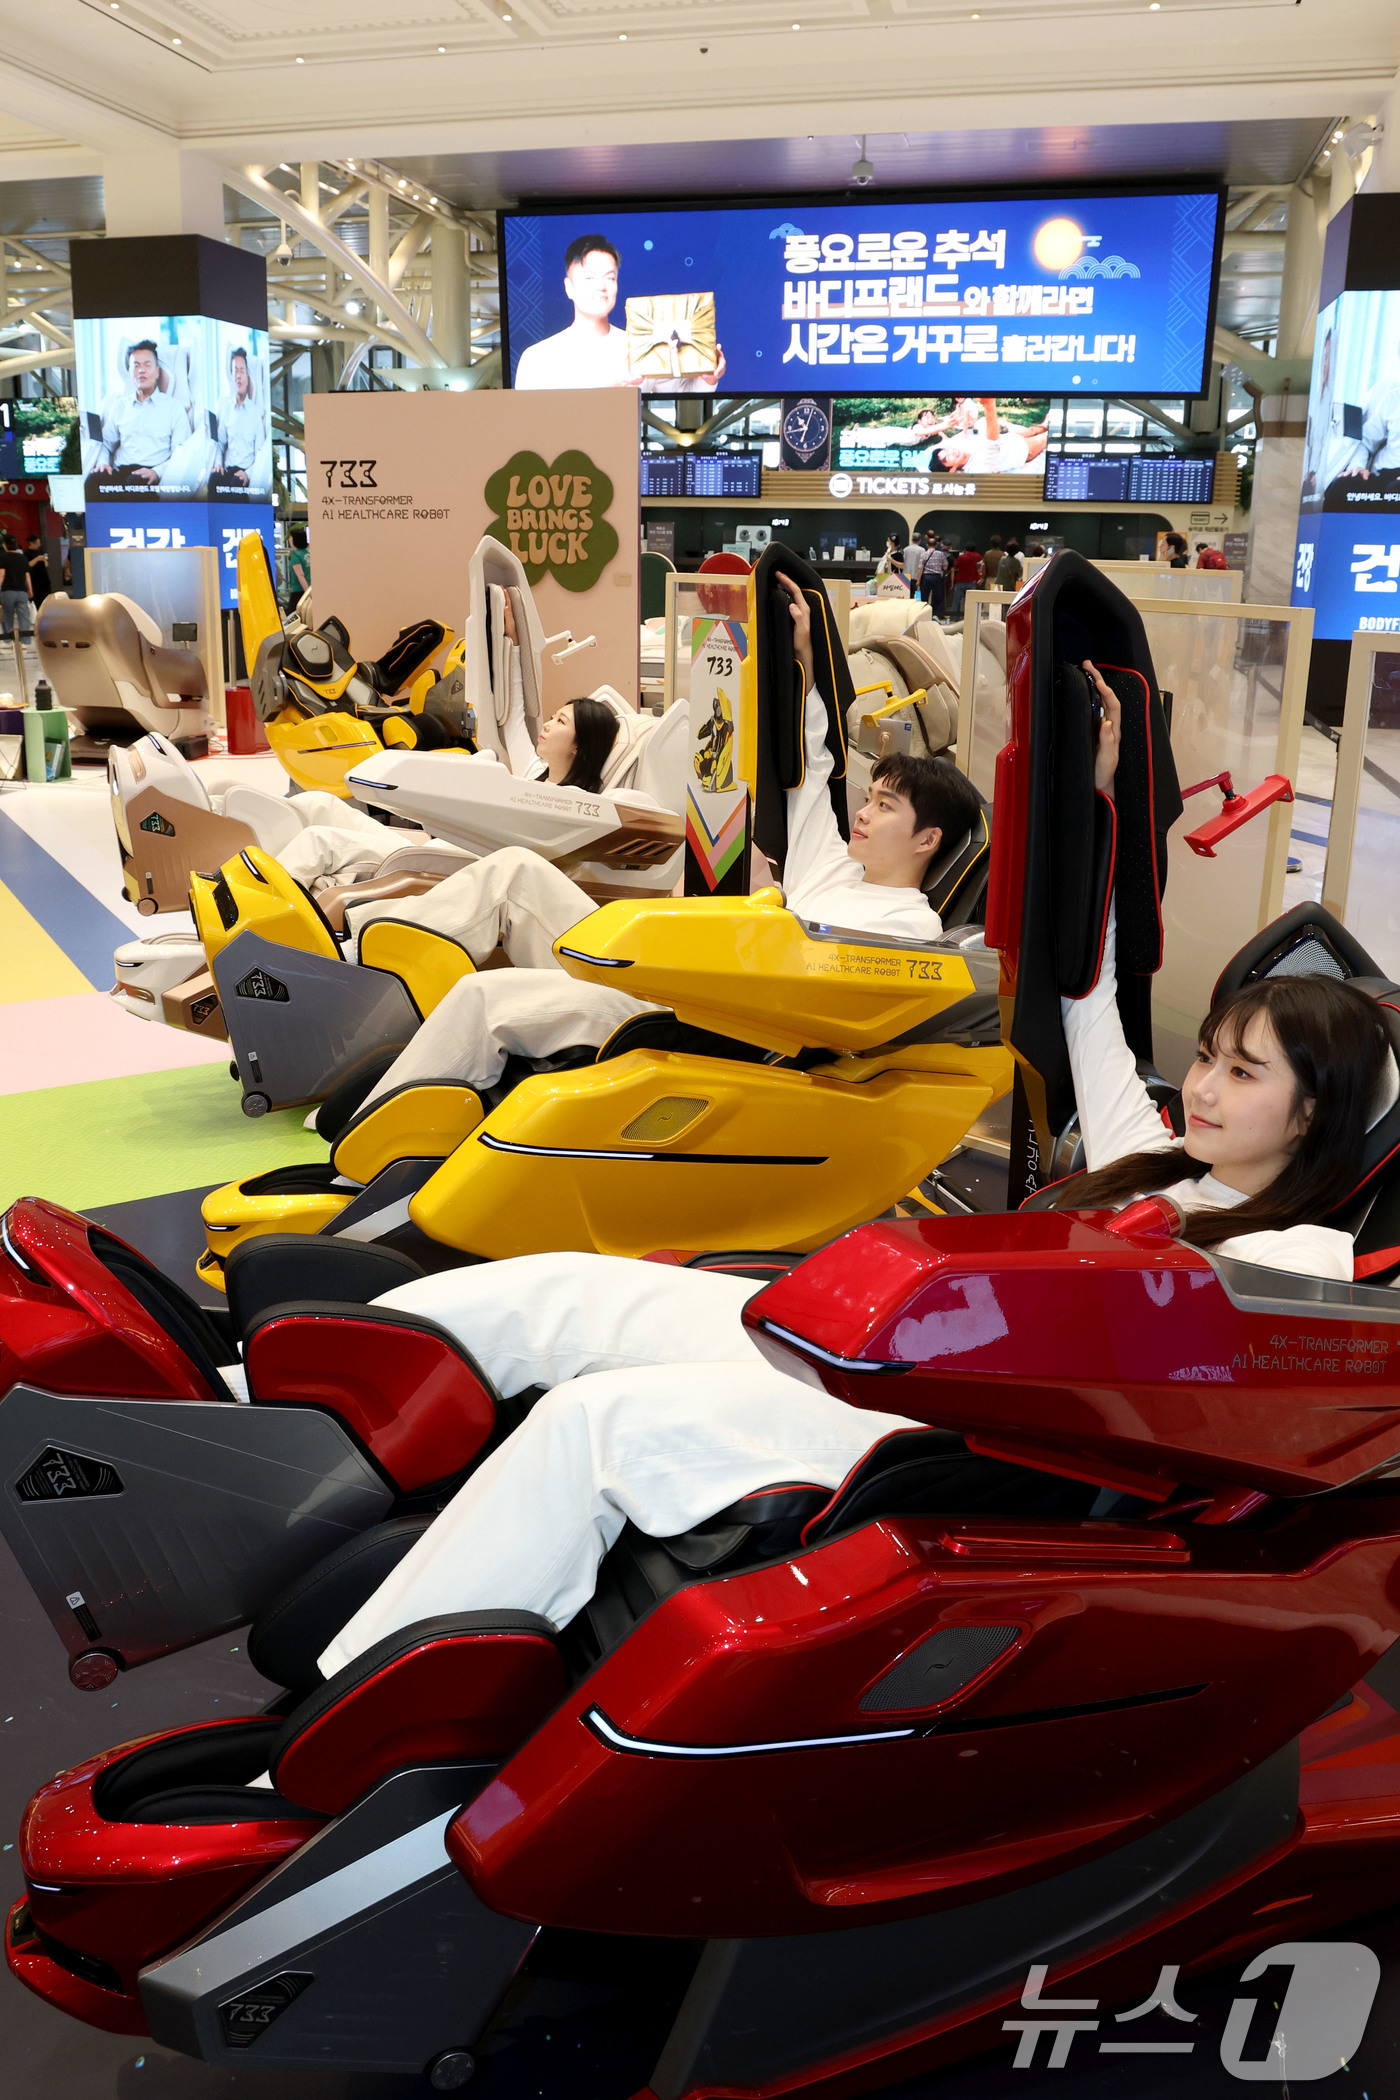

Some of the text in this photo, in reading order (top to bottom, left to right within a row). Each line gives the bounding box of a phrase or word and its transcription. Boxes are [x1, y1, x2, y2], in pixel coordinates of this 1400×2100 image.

[784, 229, 1007, 274] 풍요로운 추석
[783, 322, 1136, 365] 시간은 거꾸로 흘러갑니다!
[320, 460, 378, 488] 733
[506, 474, 593, 508] LOVE
[856, 477, 930, 495] TICKETS
[321, 495, 413, 505] 4X-TRANSFORMER
[322, 509, 450, 519] AI HEALTHCARE ROBOT
[506, 508, 593, 530] BRINGS
[509, 531, 589, 565] LUCK
[706, 656, 733, 677] 733
[517, 797, 553, 809] HEALTHCARE
[575, 800, 601, 818] 733
[150, 814, 161, 832] 733
[828, 953, 901, 966] 4X-TRANSFORMER
[818, 964, 871, 975] HEALTHCARE
[874, 967, 901, 976] ROBOT
[906, 959, 943, 981] 733
[250, 971, 267, 998] 733
[193, 1003, 210, 1016] 733
[1270, 1334, 1389, 1354] 4X-TRANSFORMER
[1231, 1353, 1388, 1374] AI HEALTHCARE ROBOT
[42, 1452, 77, 1496] 733
[229, 2003, 276, 2023] 733
